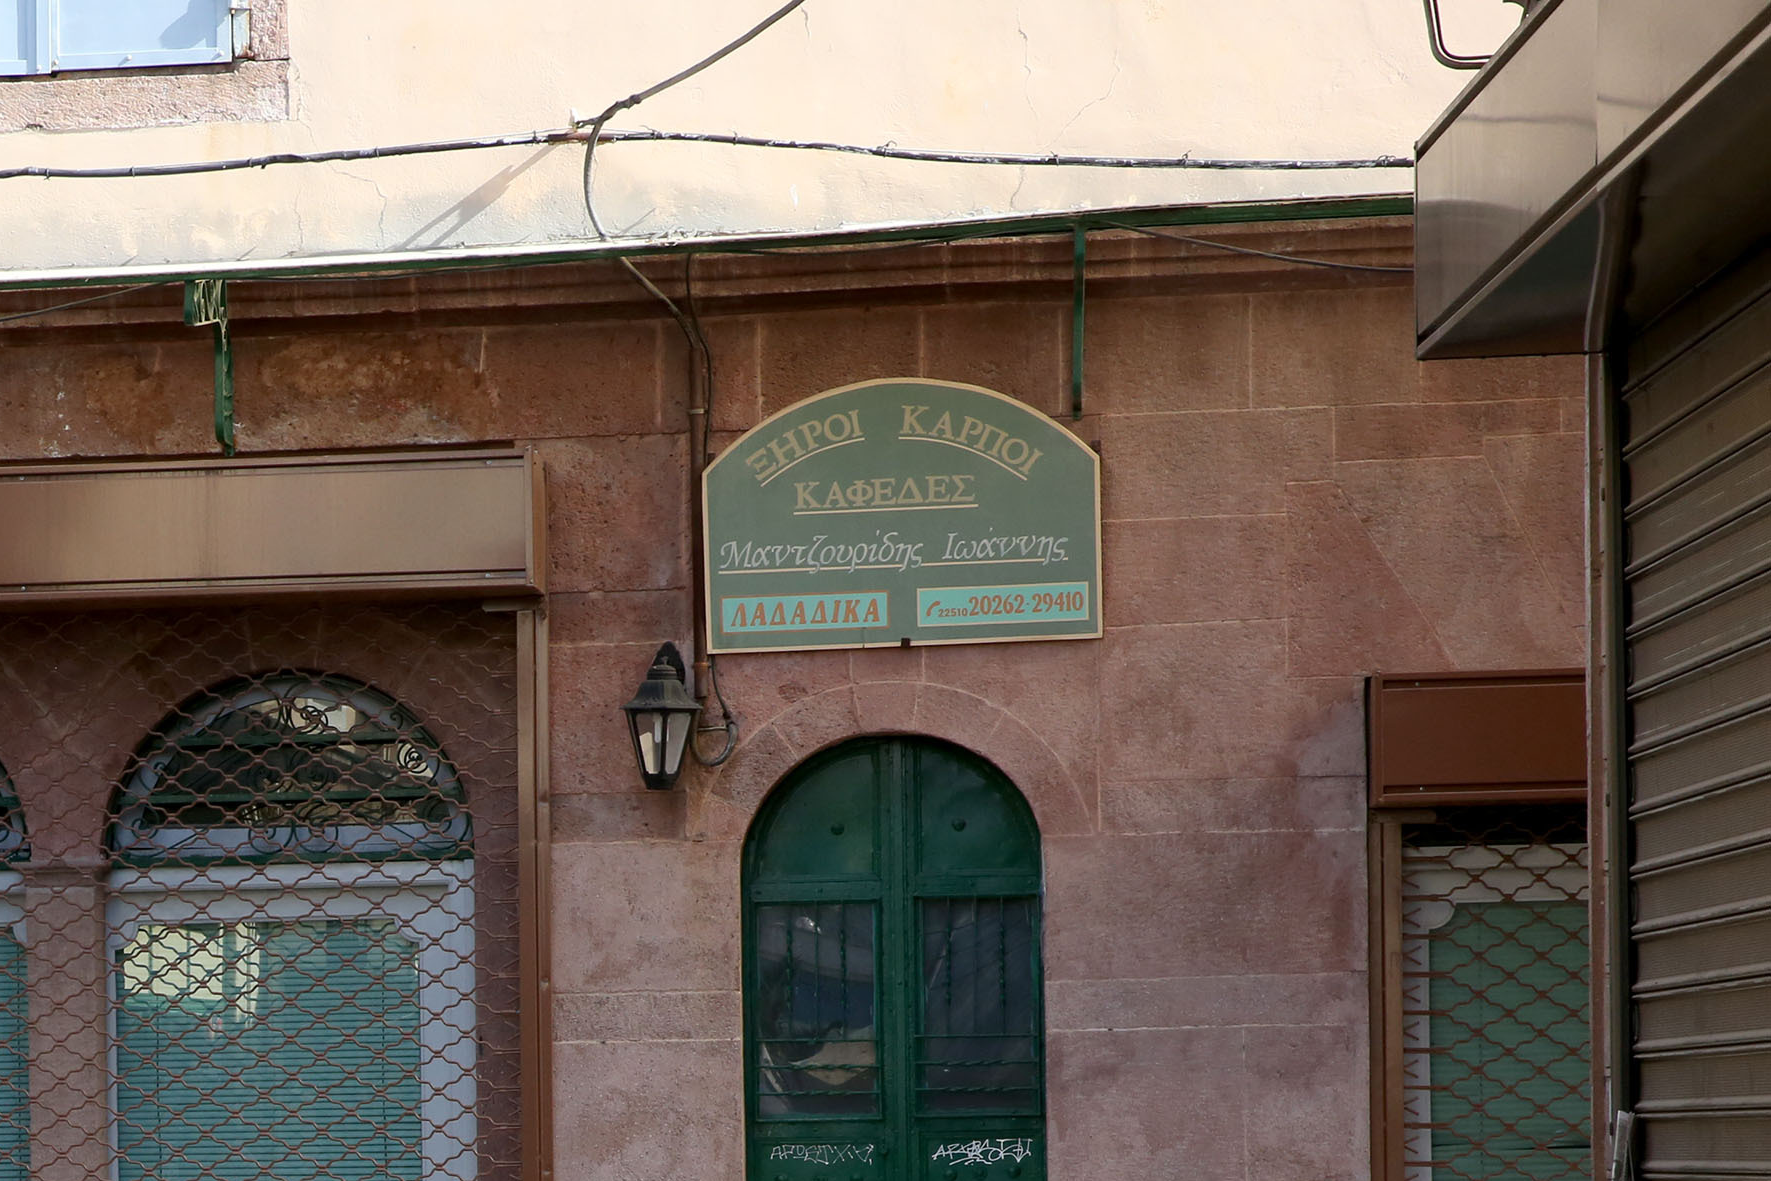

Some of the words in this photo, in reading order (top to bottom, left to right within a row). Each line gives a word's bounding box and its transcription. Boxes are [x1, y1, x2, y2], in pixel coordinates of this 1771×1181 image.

[745, 409, 864, 481] ΞΗΡΟΙ
[899, 405, 1044, 475] ΚΑΡΠΟΙ
[794, 475, 976, 510] ΚΑΦΕΔΕΣ
[719, 529, 924, 574] Μαντζουρίδης
[942, 527, 1069, 566] Ιωάννης
[731, 598, 880, 627] ΛΑΔΑΔΙΚΑ
[938, 608, 968, 617] 22510
